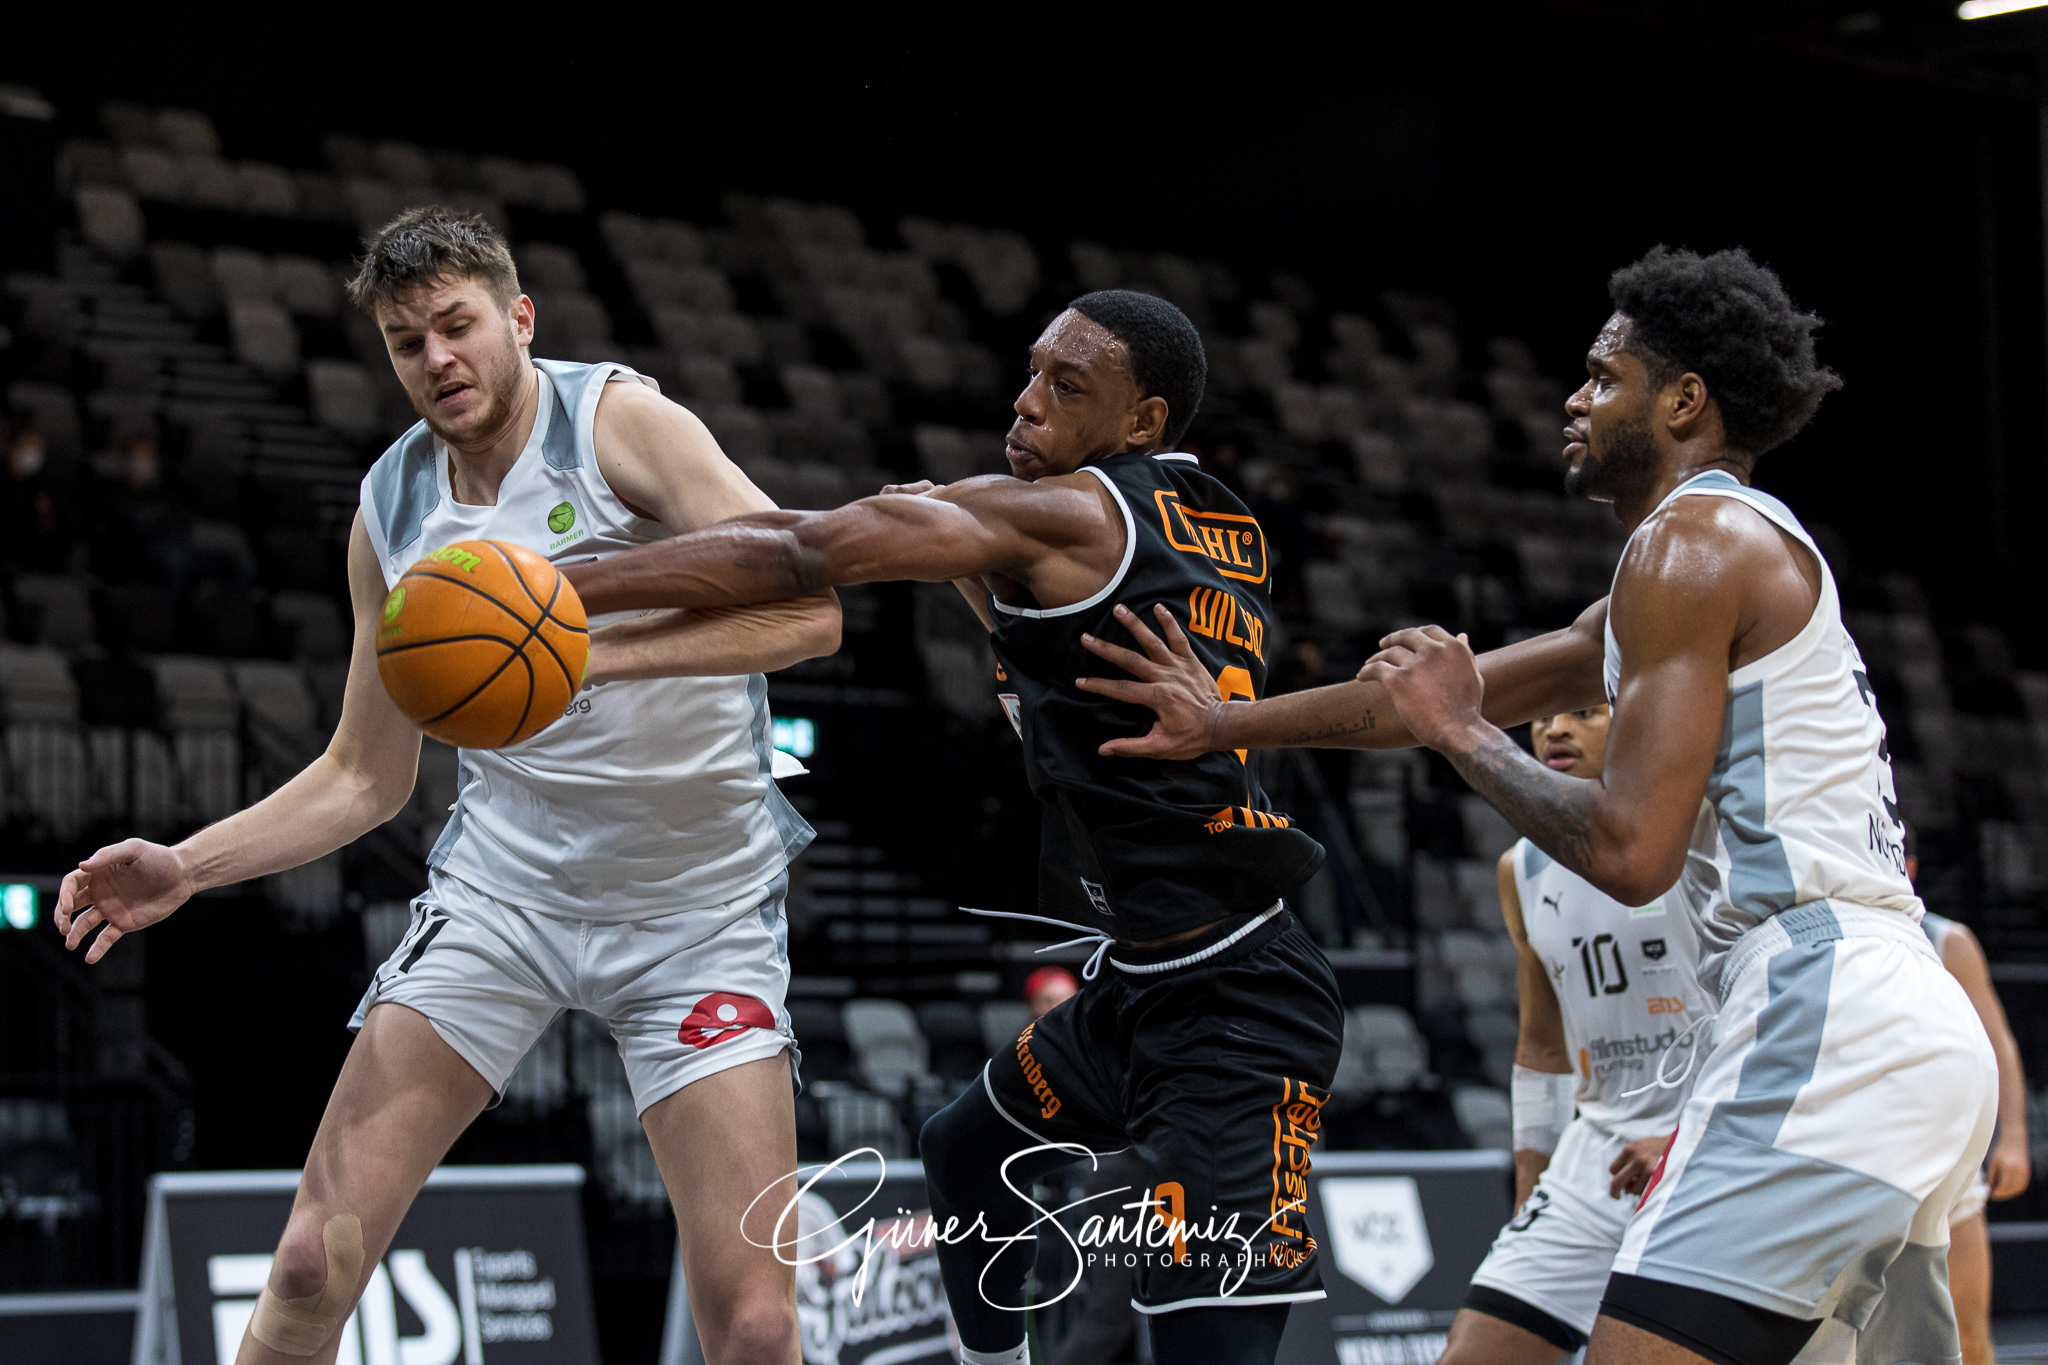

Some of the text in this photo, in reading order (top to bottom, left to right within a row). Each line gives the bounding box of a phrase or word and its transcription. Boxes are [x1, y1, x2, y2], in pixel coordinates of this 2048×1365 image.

[549, 529, 585, 551] BARMER
[1571, 933, 1629, 998] 10
[1590, 1026, 1695, 1061] filmstudo
